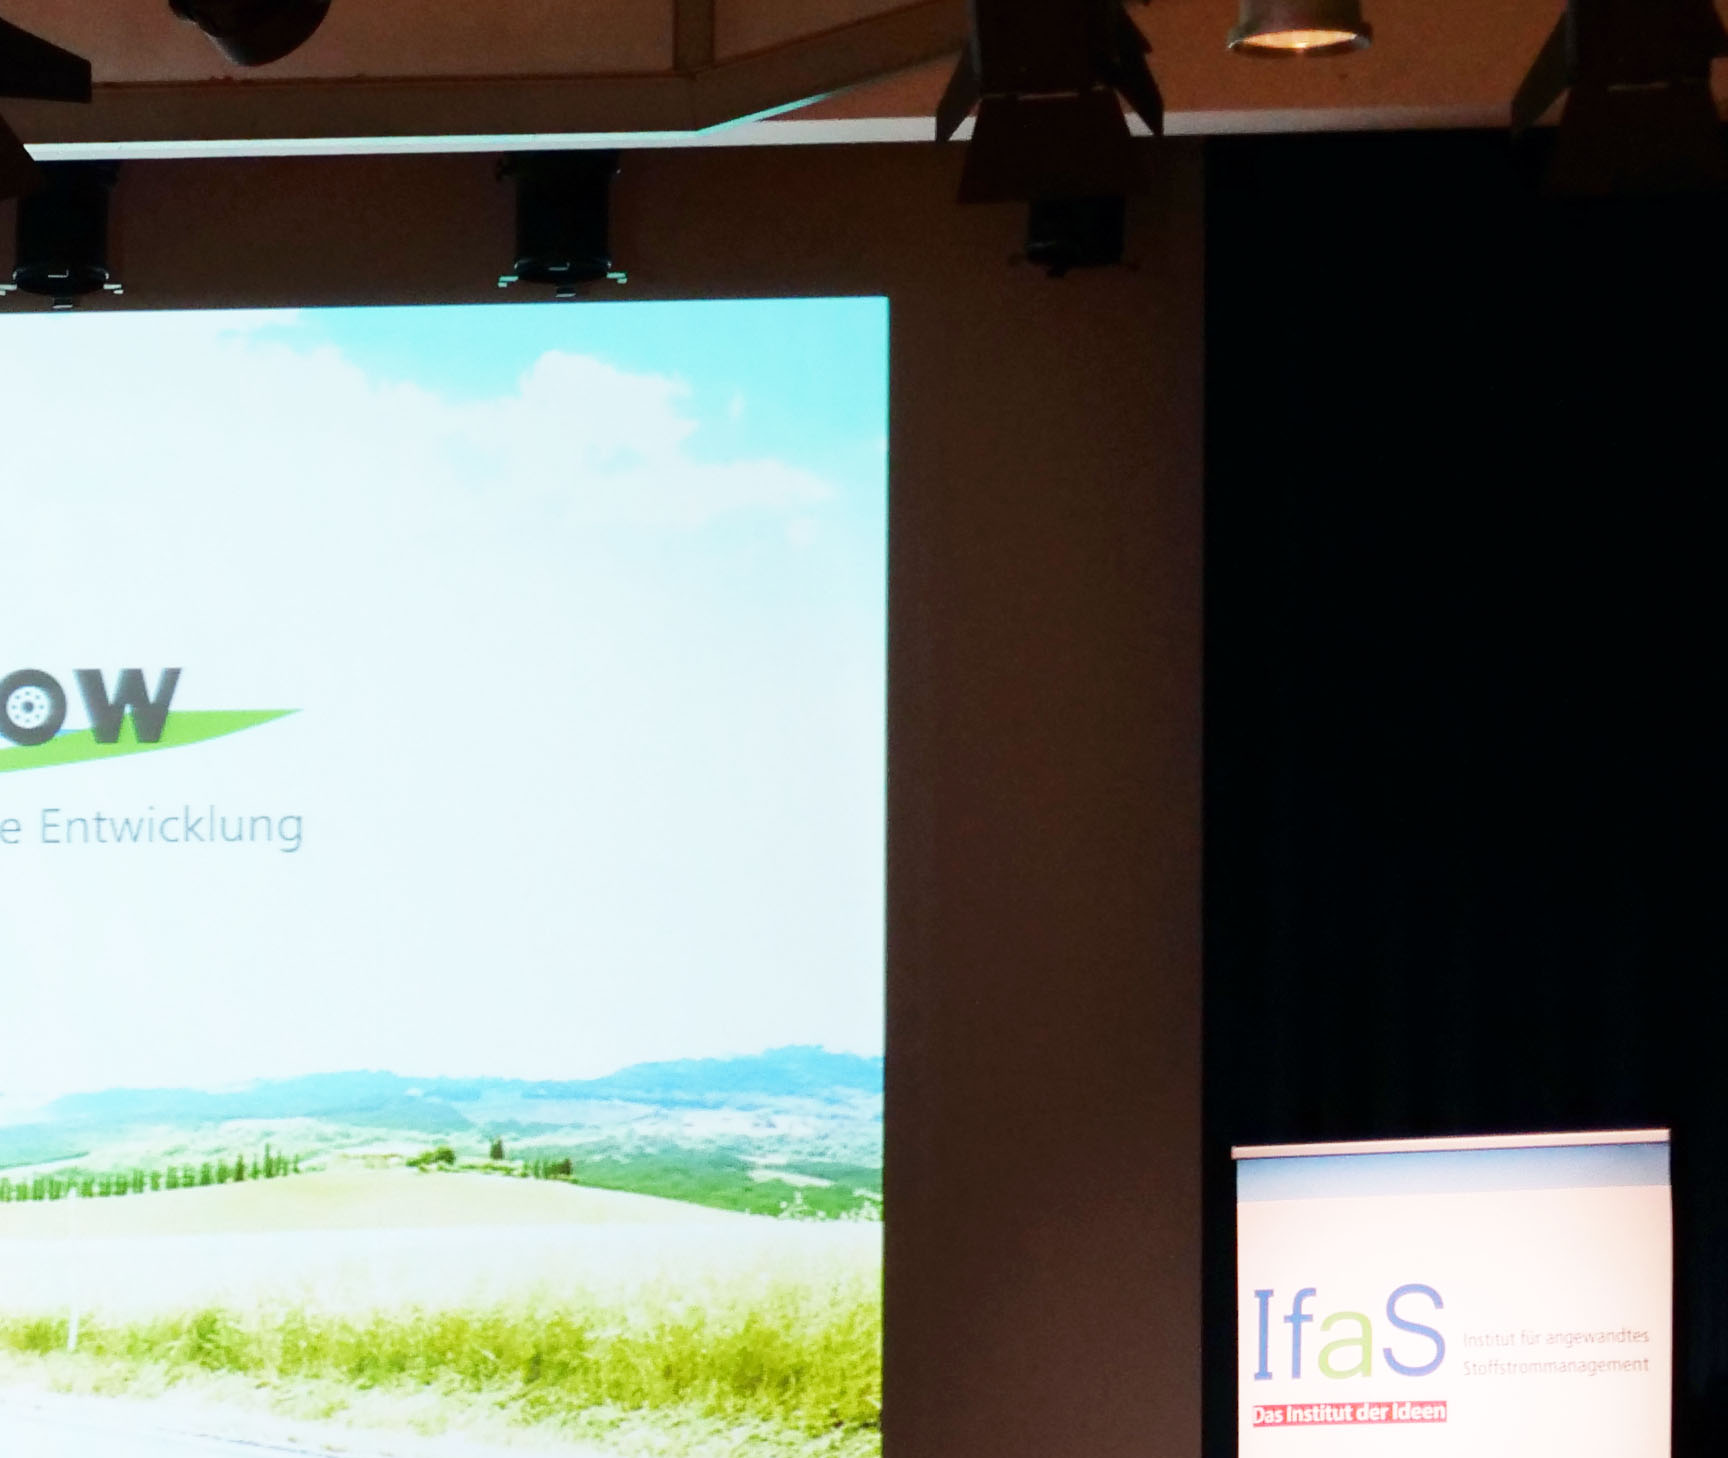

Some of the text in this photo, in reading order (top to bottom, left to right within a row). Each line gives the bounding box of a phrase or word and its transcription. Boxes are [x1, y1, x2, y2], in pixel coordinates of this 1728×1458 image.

[40, 804, 305, 854] Entwicklung
[1253, 1283, 1446, 1381] IfaS
[1463, 1328, 1650, 1349] Institut für angewandtes
[1463, 1357, 1650, 1377] Stoffstrommanagement
[1253, 1401, 1446, 1426] Das Institut der Ideen
